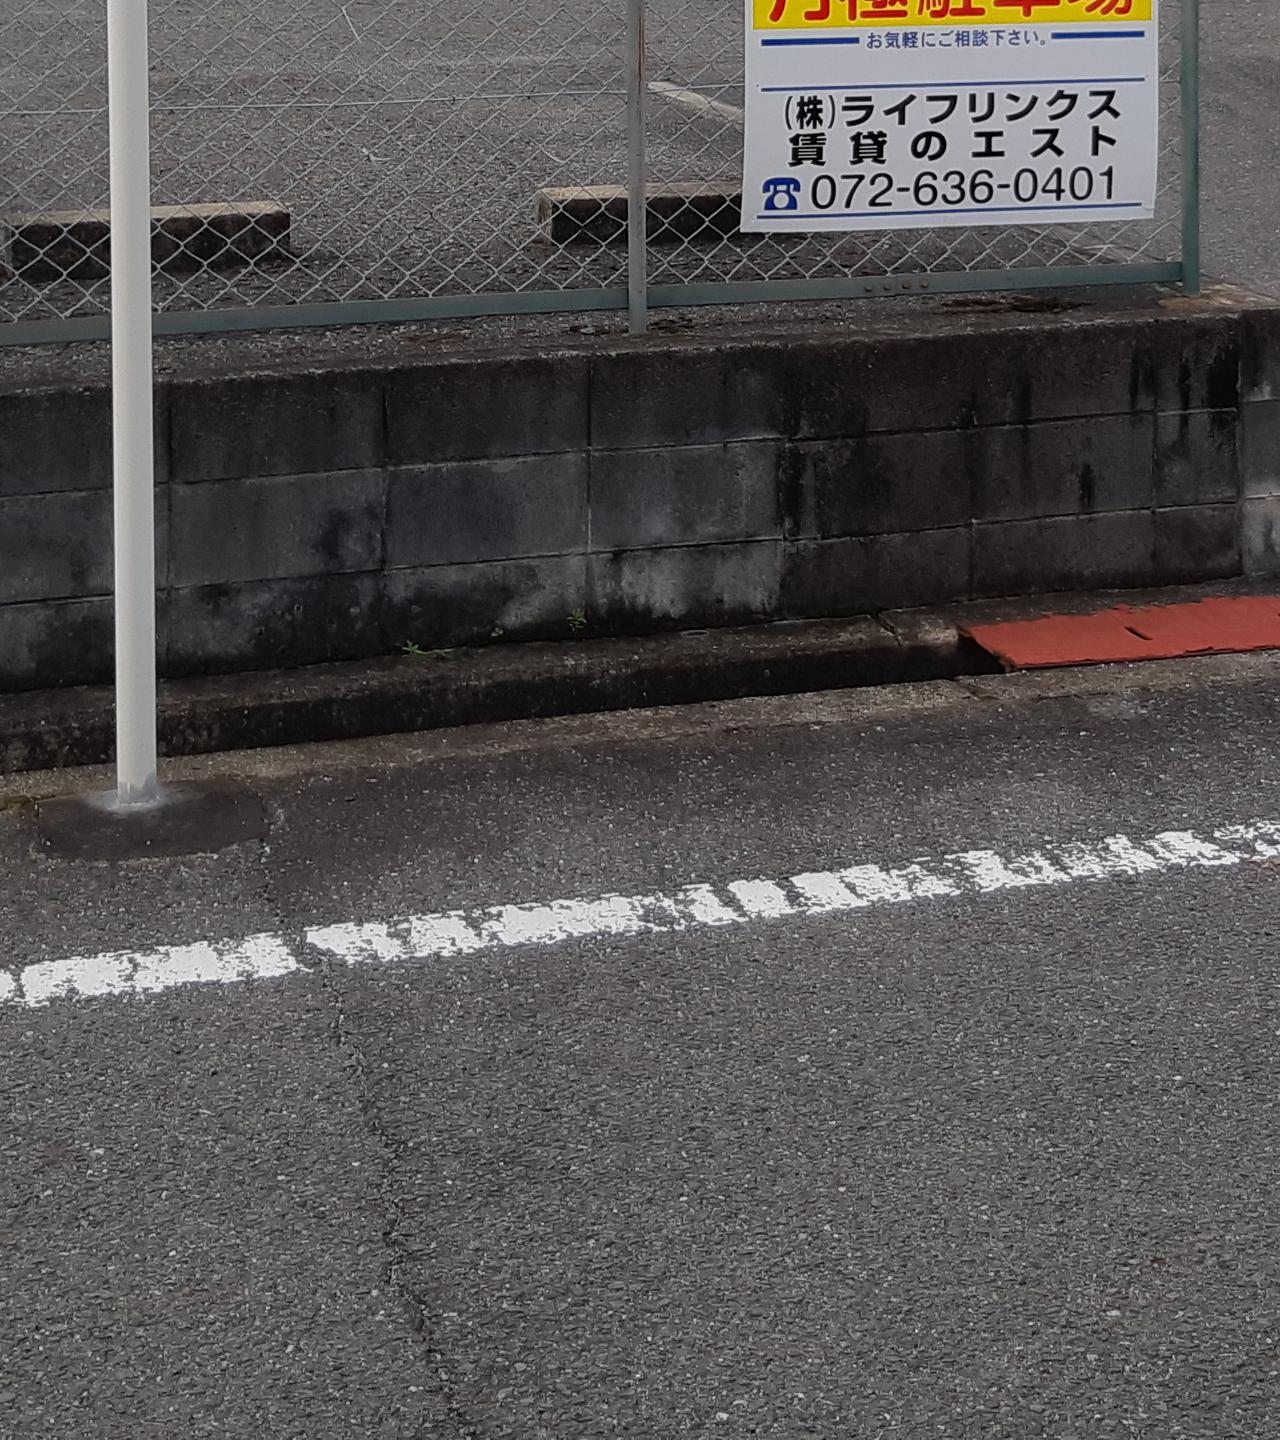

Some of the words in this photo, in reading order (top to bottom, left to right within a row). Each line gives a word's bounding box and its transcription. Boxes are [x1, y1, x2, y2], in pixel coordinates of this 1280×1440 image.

[867, 30, 1047, 49] お気軽にご相談下さい。
[785, 90, 1121, 130] (株)ライフリンクス
[788, 126, 1117, 166] 賃貸のエスト
[811, 166, 1115, 209] 072-636-0401
